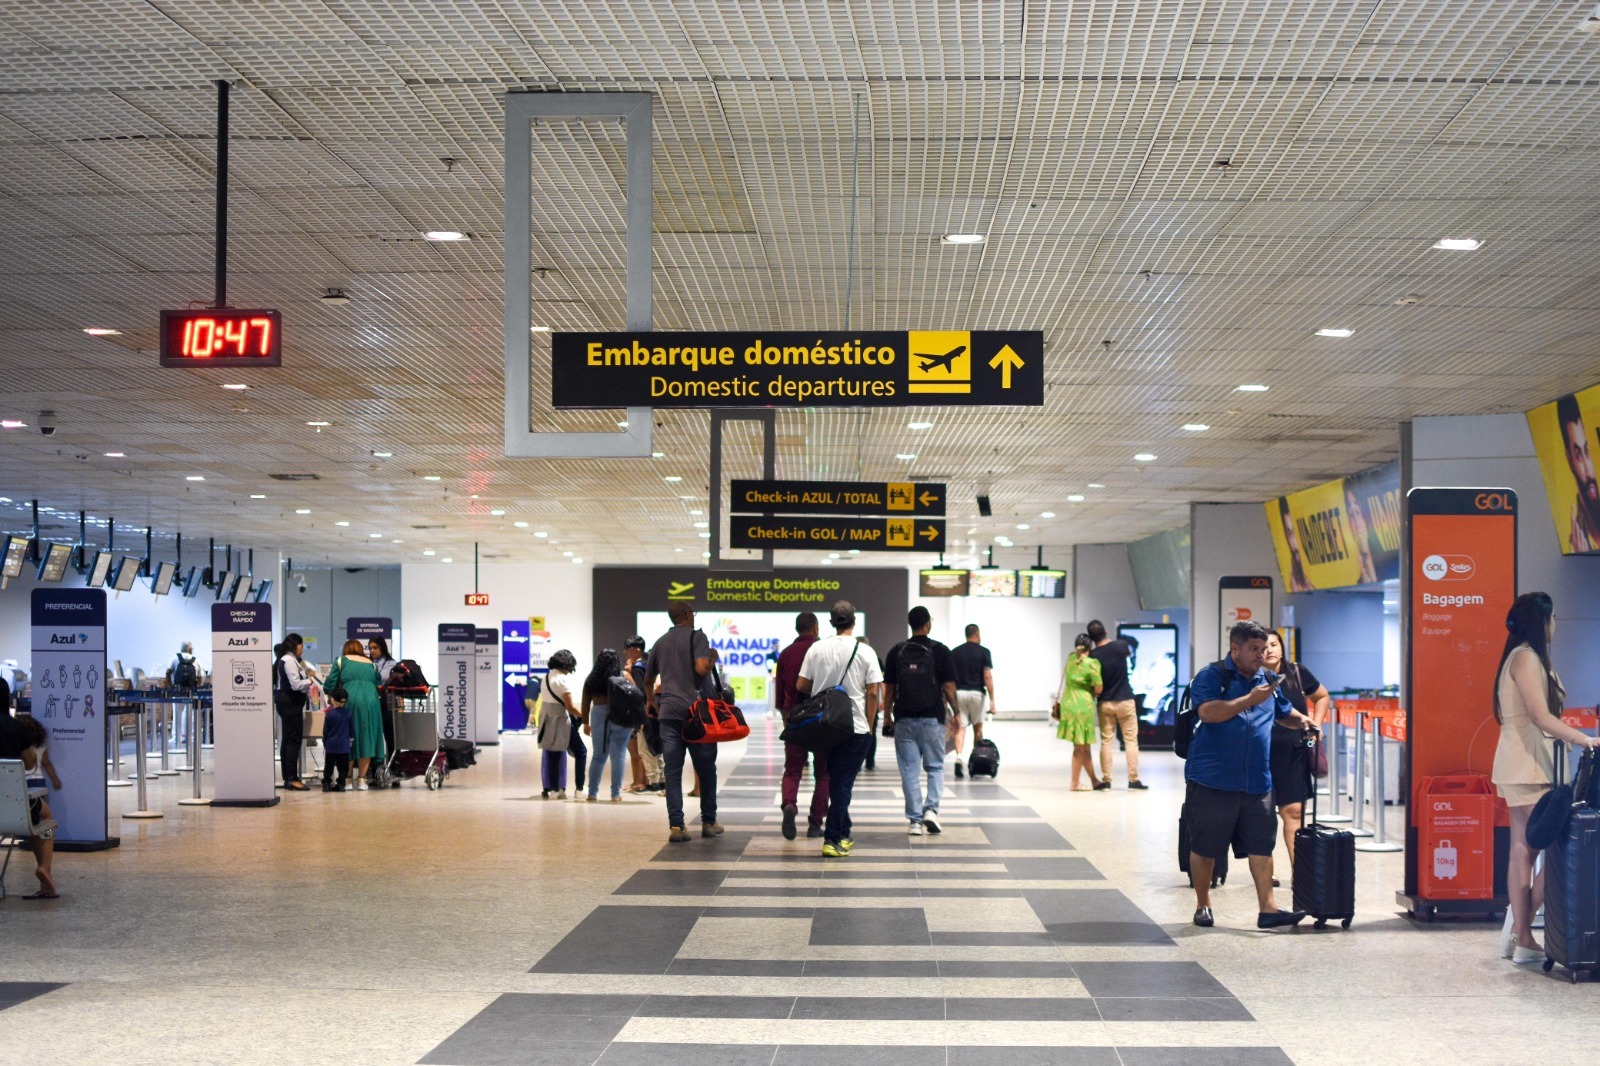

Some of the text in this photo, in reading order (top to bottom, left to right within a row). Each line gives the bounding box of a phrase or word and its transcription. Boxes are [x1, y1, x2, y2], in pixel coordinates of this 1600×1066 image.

[183, 319, 270, 357] 10:47
[587, 340, 896, 371] Embarque doméstico
[651, 375, 896, 401] Domestic departures
[745, 491, 798, 503] Check-in
[801, 492, 833, 504] AZUL
[844, 493, 881, 505] TOTAL
[1475, 493, 1513, 510] GOL
[748, 526, 806, 539] Check-in
[810, 528, 838, 540] GOL
[850, 529, 881, 541] MAP
[706, 578, 840, 591] Embarque Doméstico
[1251, 578, 1270, 587] GOL
[706, 591, 825, 603] Domestic Departure
[1423, 593, 1484, 607] Bagagem
[1422, 613, 1452, 624] Baggage
[1422, 627, 1451, 637] Equipaje
[50, 633, 76, 645] Azul
[228, 638, 249, 646] Azul
[456, 661, 467, 739] Internacional
[443, 685, 454, 739] Check-in
[1433, 802, 1453, 811] GOL
[1436, 858, 1455, 866] 10kg
